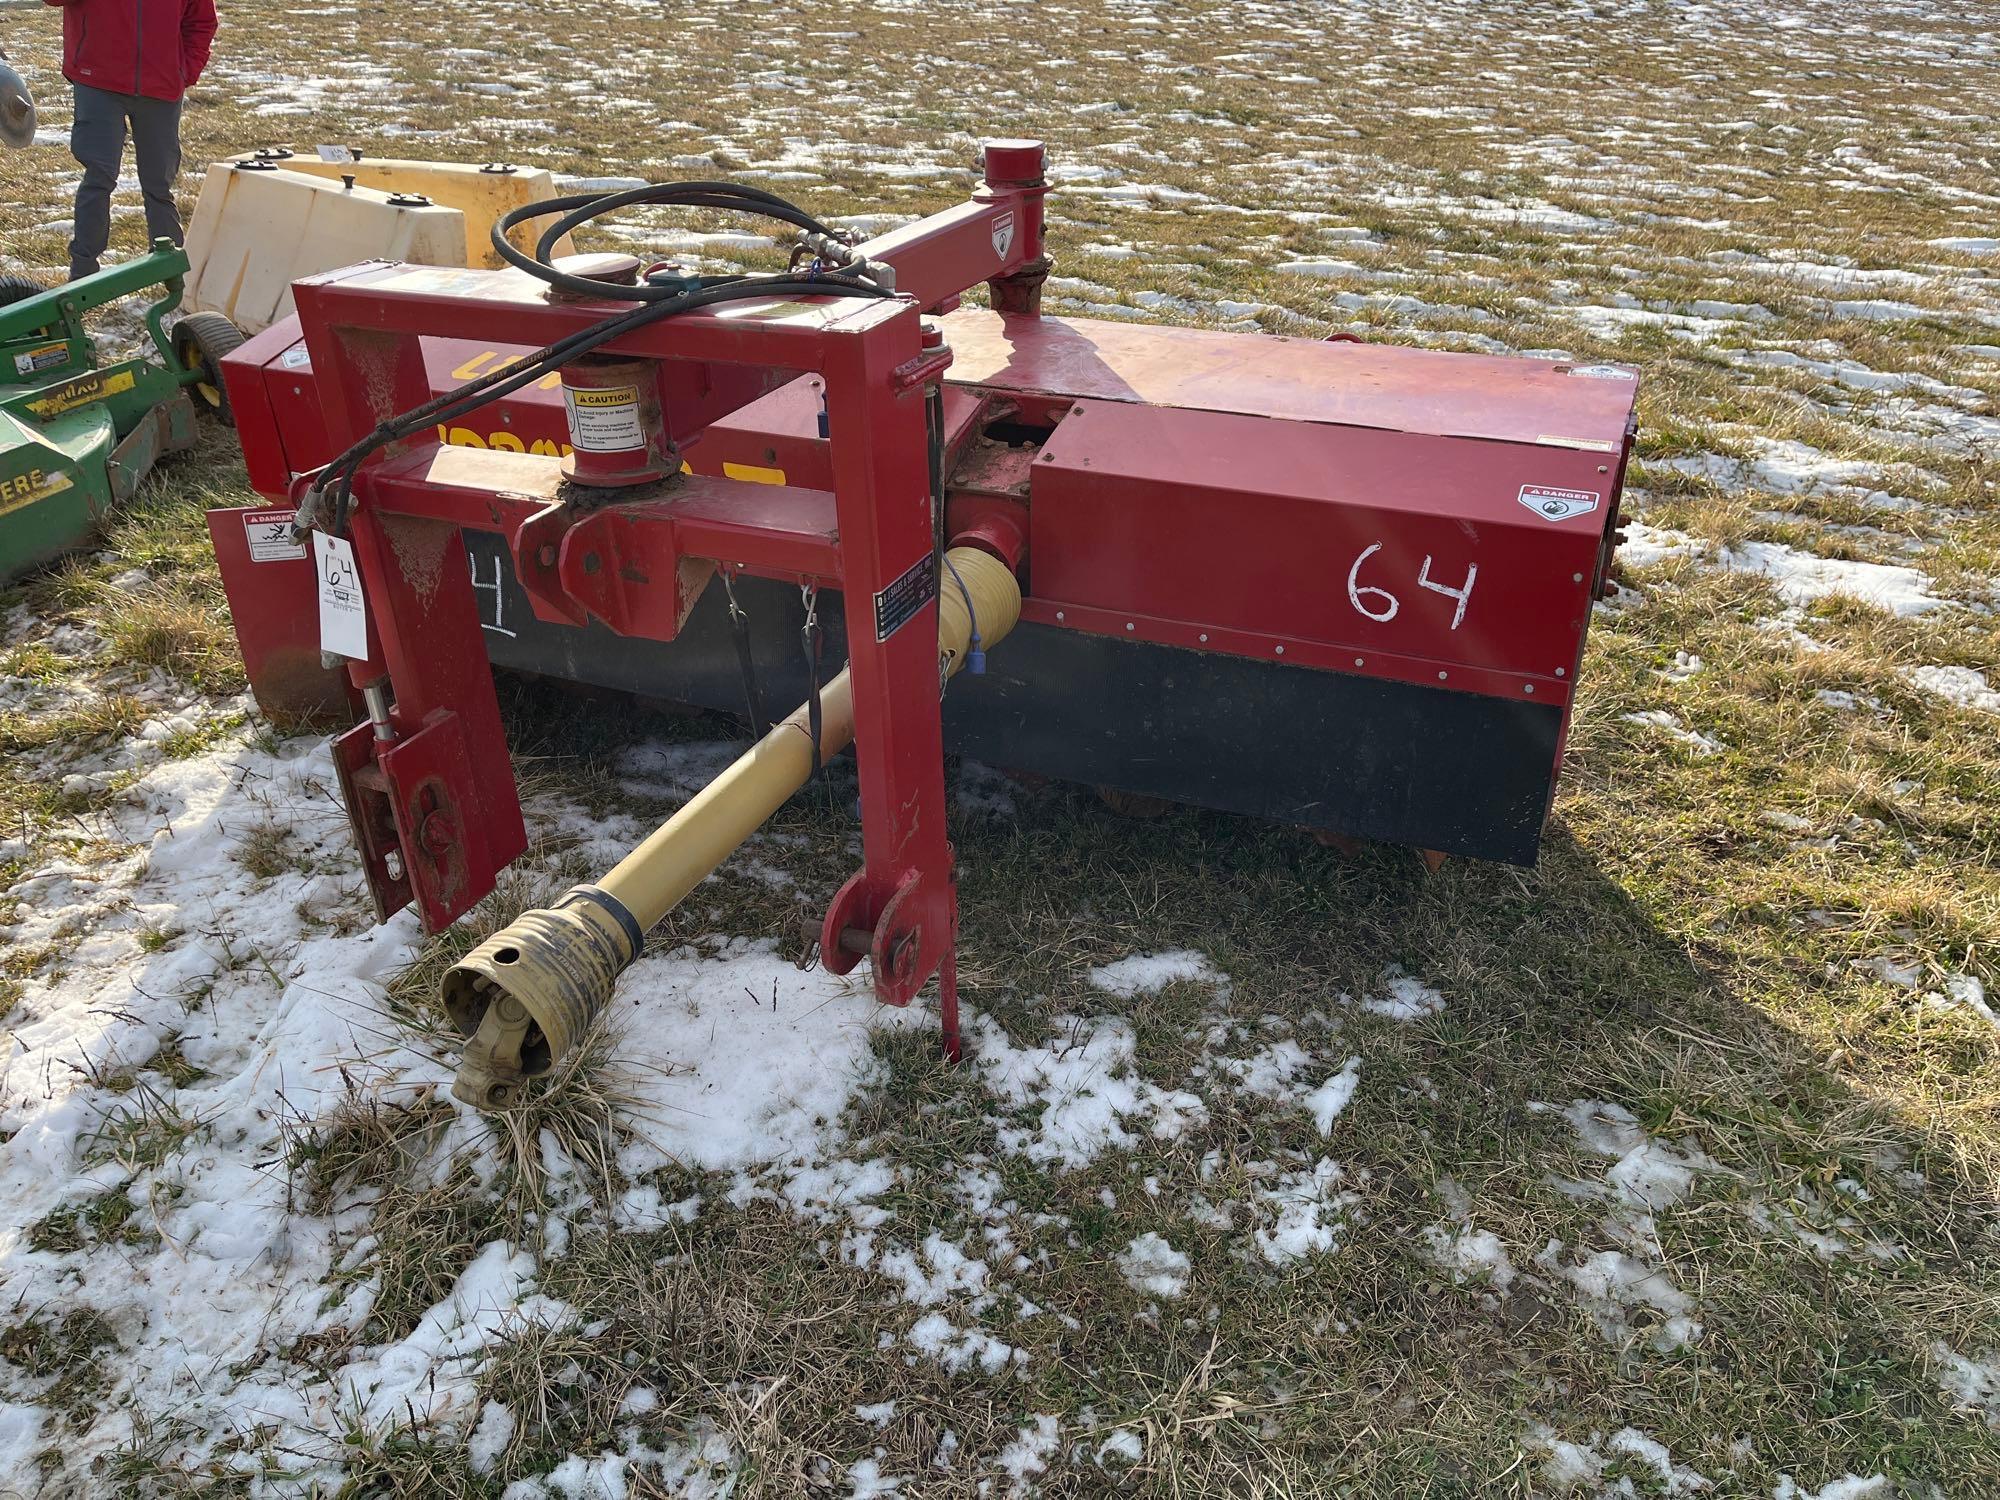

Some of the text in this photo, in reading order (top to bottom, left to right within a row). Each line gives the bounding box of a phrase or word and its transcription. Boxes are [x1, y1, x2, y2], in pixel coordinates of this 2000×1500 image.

[588, 393, 631, 404] CAUTION
[1542, 490, 1589, 500] DANGER
[259, 514, 293, 522] DANGER
[325, 554, 355, 590] 64
[1348, 540, 1478, 630] 64
